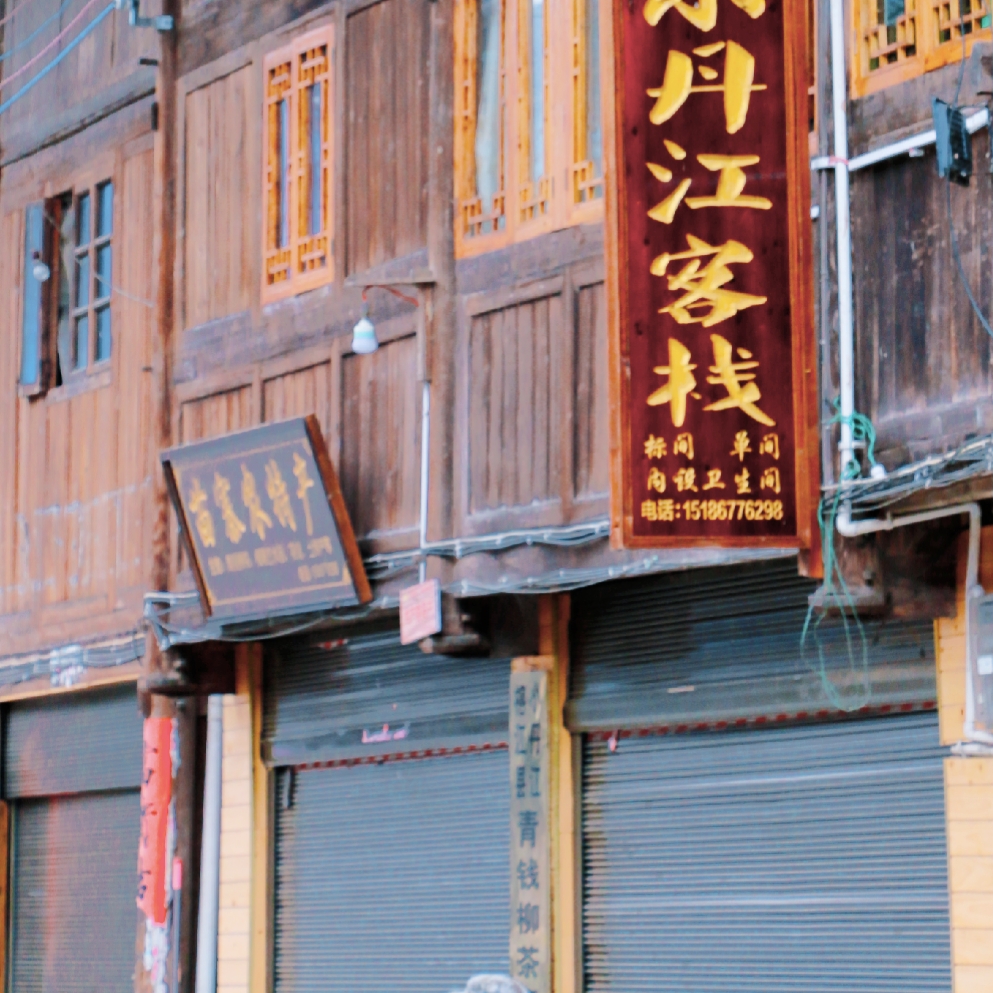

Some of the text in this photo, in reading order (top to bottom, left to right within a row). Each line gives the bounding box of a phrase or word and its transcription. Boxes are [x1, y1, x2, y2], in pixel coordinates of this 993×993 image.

[643, 430, 781, 462] 标间 单间
[646, 466, 782, 494] 内设卫生间
[516, 810, 541, 993] 青钱柳茶
